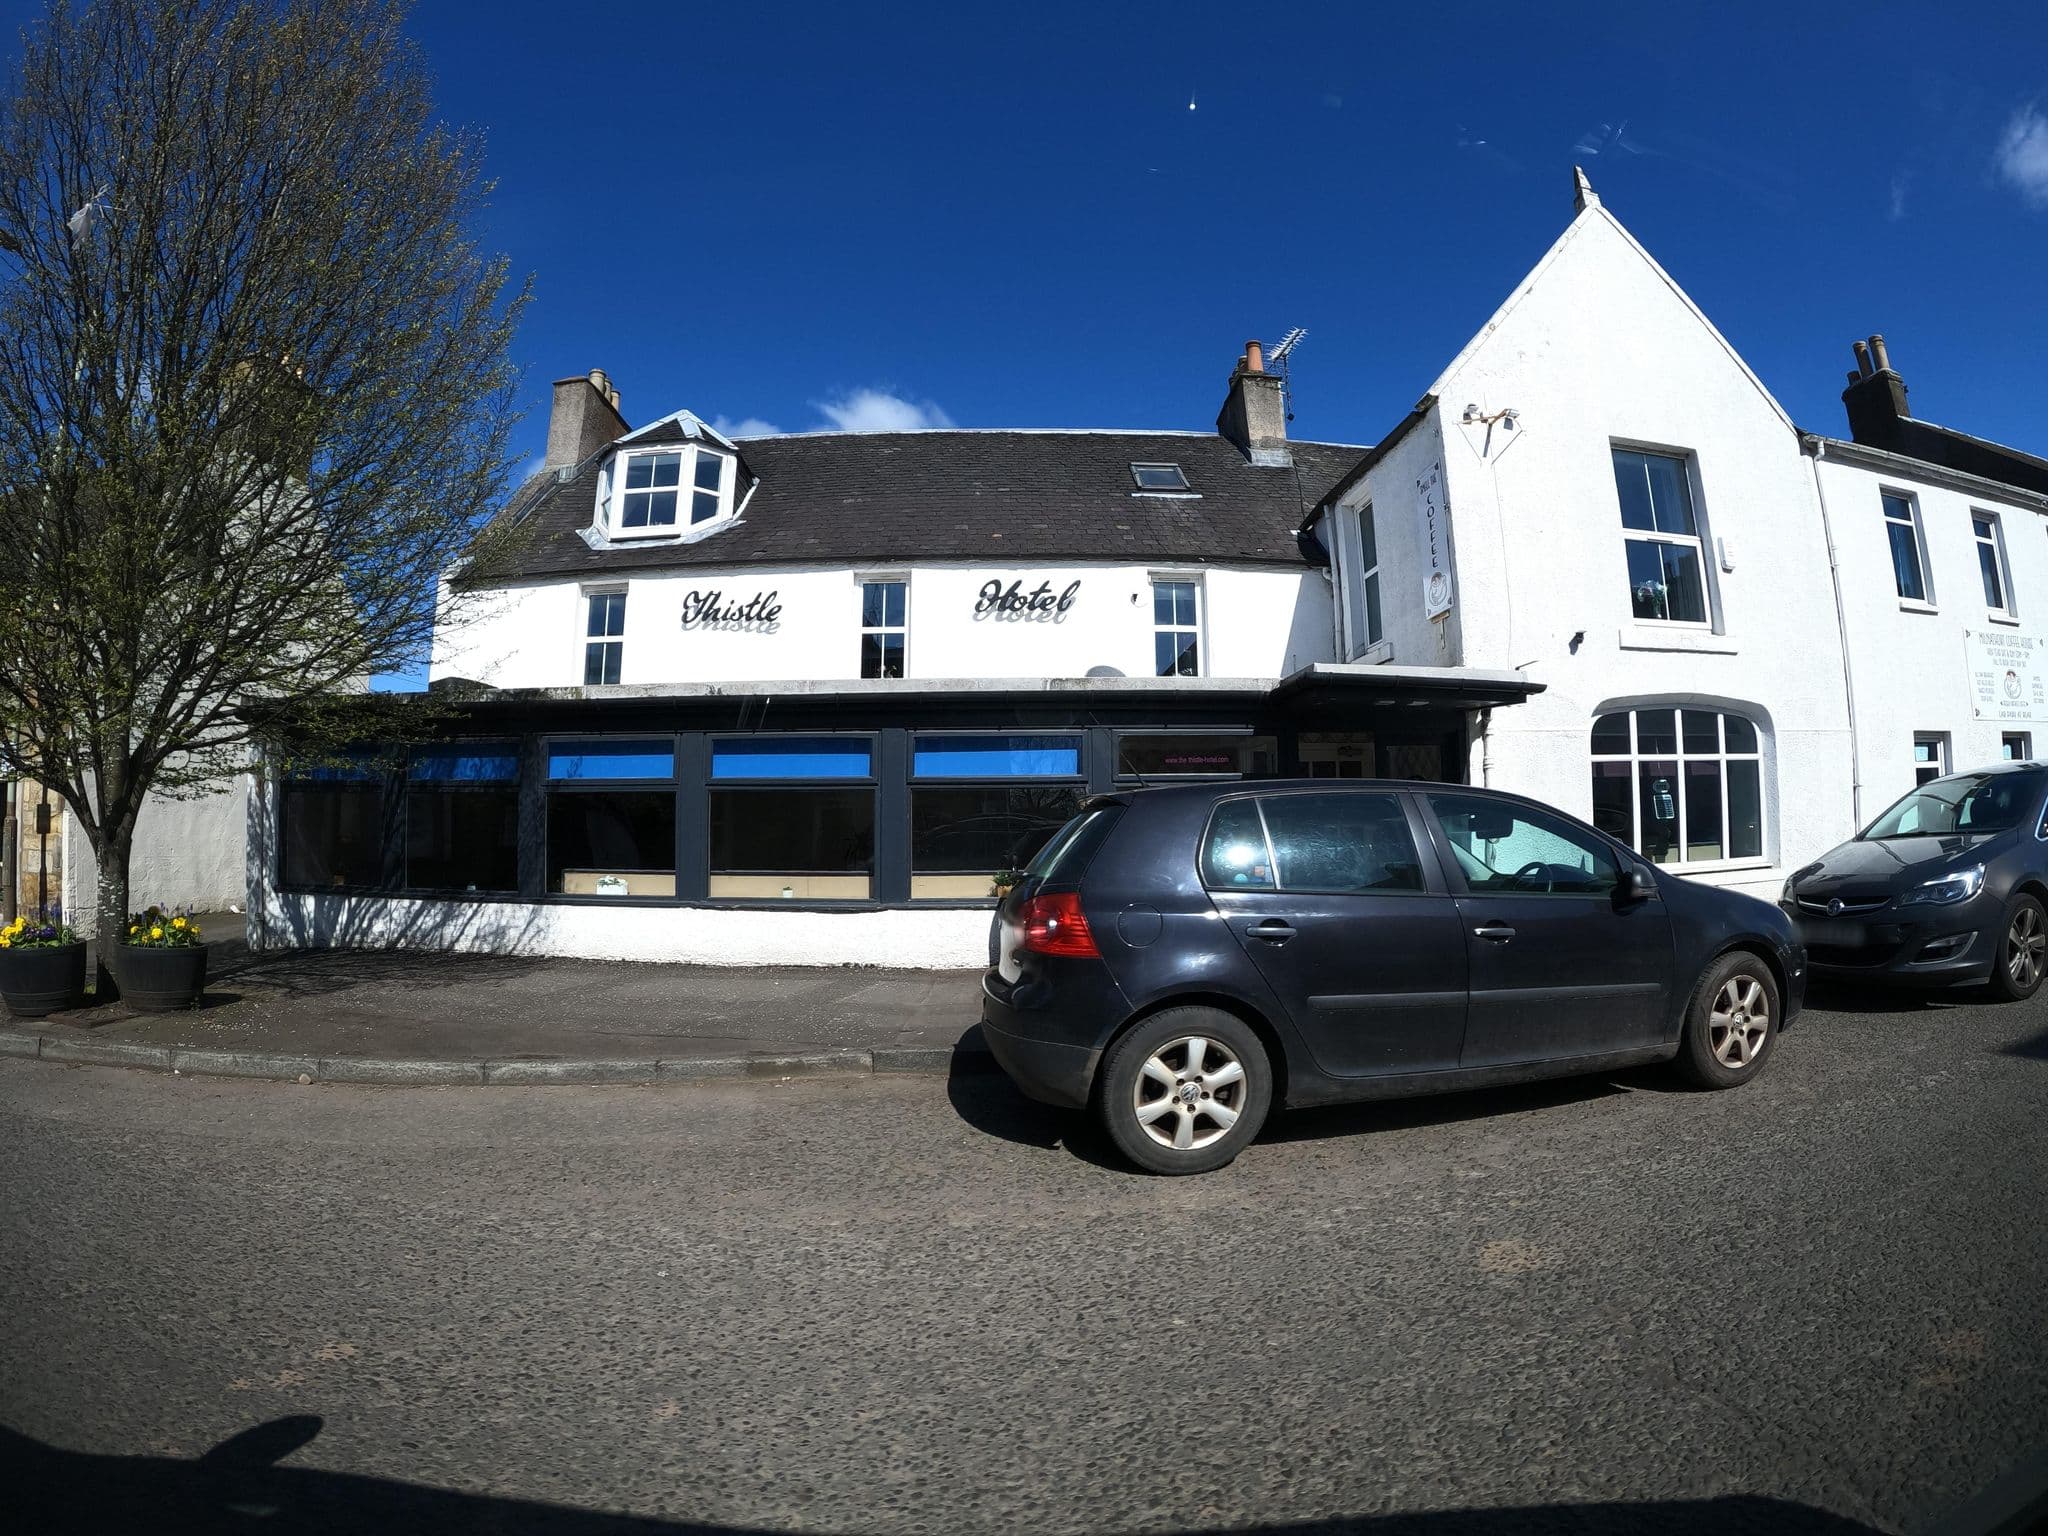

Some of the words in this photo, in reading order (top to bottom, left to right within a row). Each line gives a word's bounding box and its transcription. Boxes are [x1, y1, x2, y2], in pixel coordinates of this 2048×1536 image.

[1426, 492, 1439, 568] COFFEE
[681, 590, 783, 626] Thistle
[974, 579, 1082, 615] Hotel
